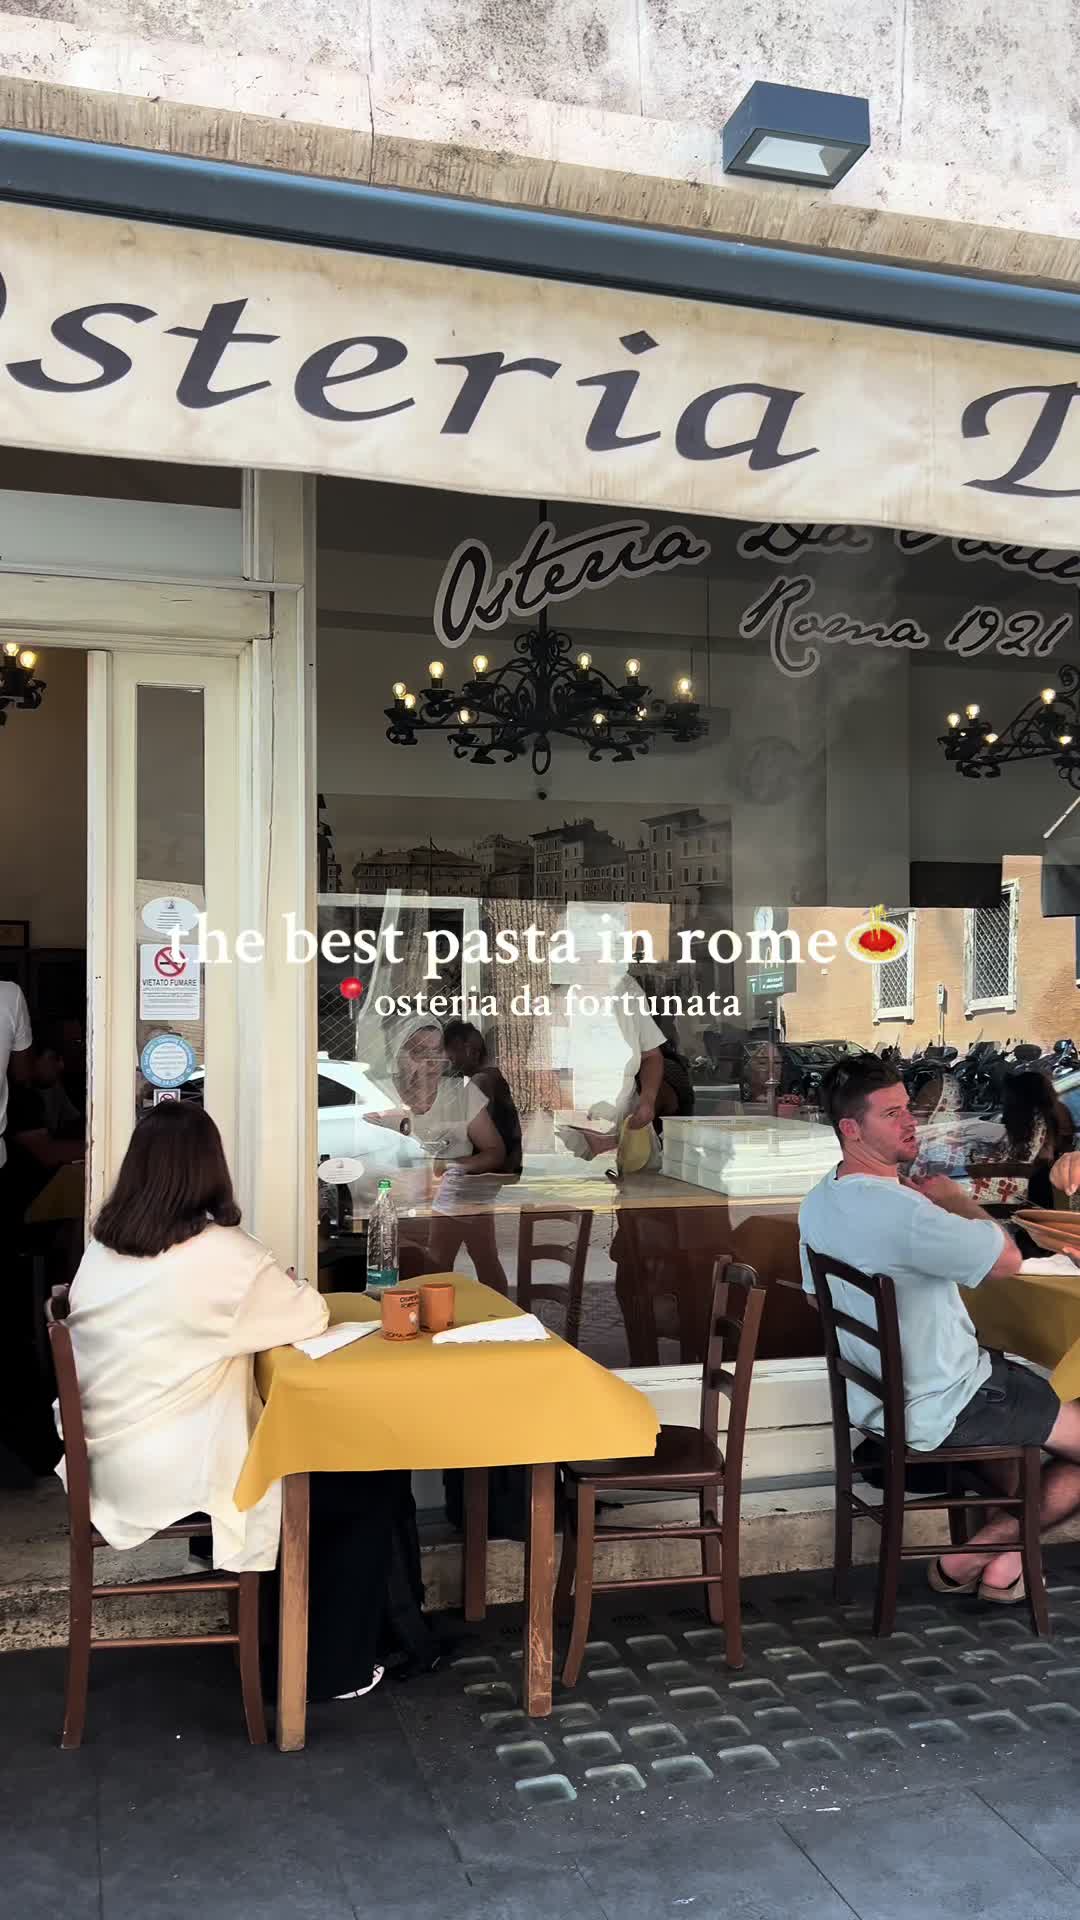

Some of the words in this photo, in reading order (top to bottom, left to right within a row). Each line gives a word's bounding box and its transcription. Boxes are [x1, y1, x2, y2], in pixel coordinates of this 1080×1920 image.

[0, 272, 819, 470] steria
[433, 518, 710, 649] Osteria
[739, 575, 929, 678] Roma
[945, 607, 1073, 656] 1921
[143, 978, 168, 987] VIETATO
[170, 978, 197, 987] FUMARE
